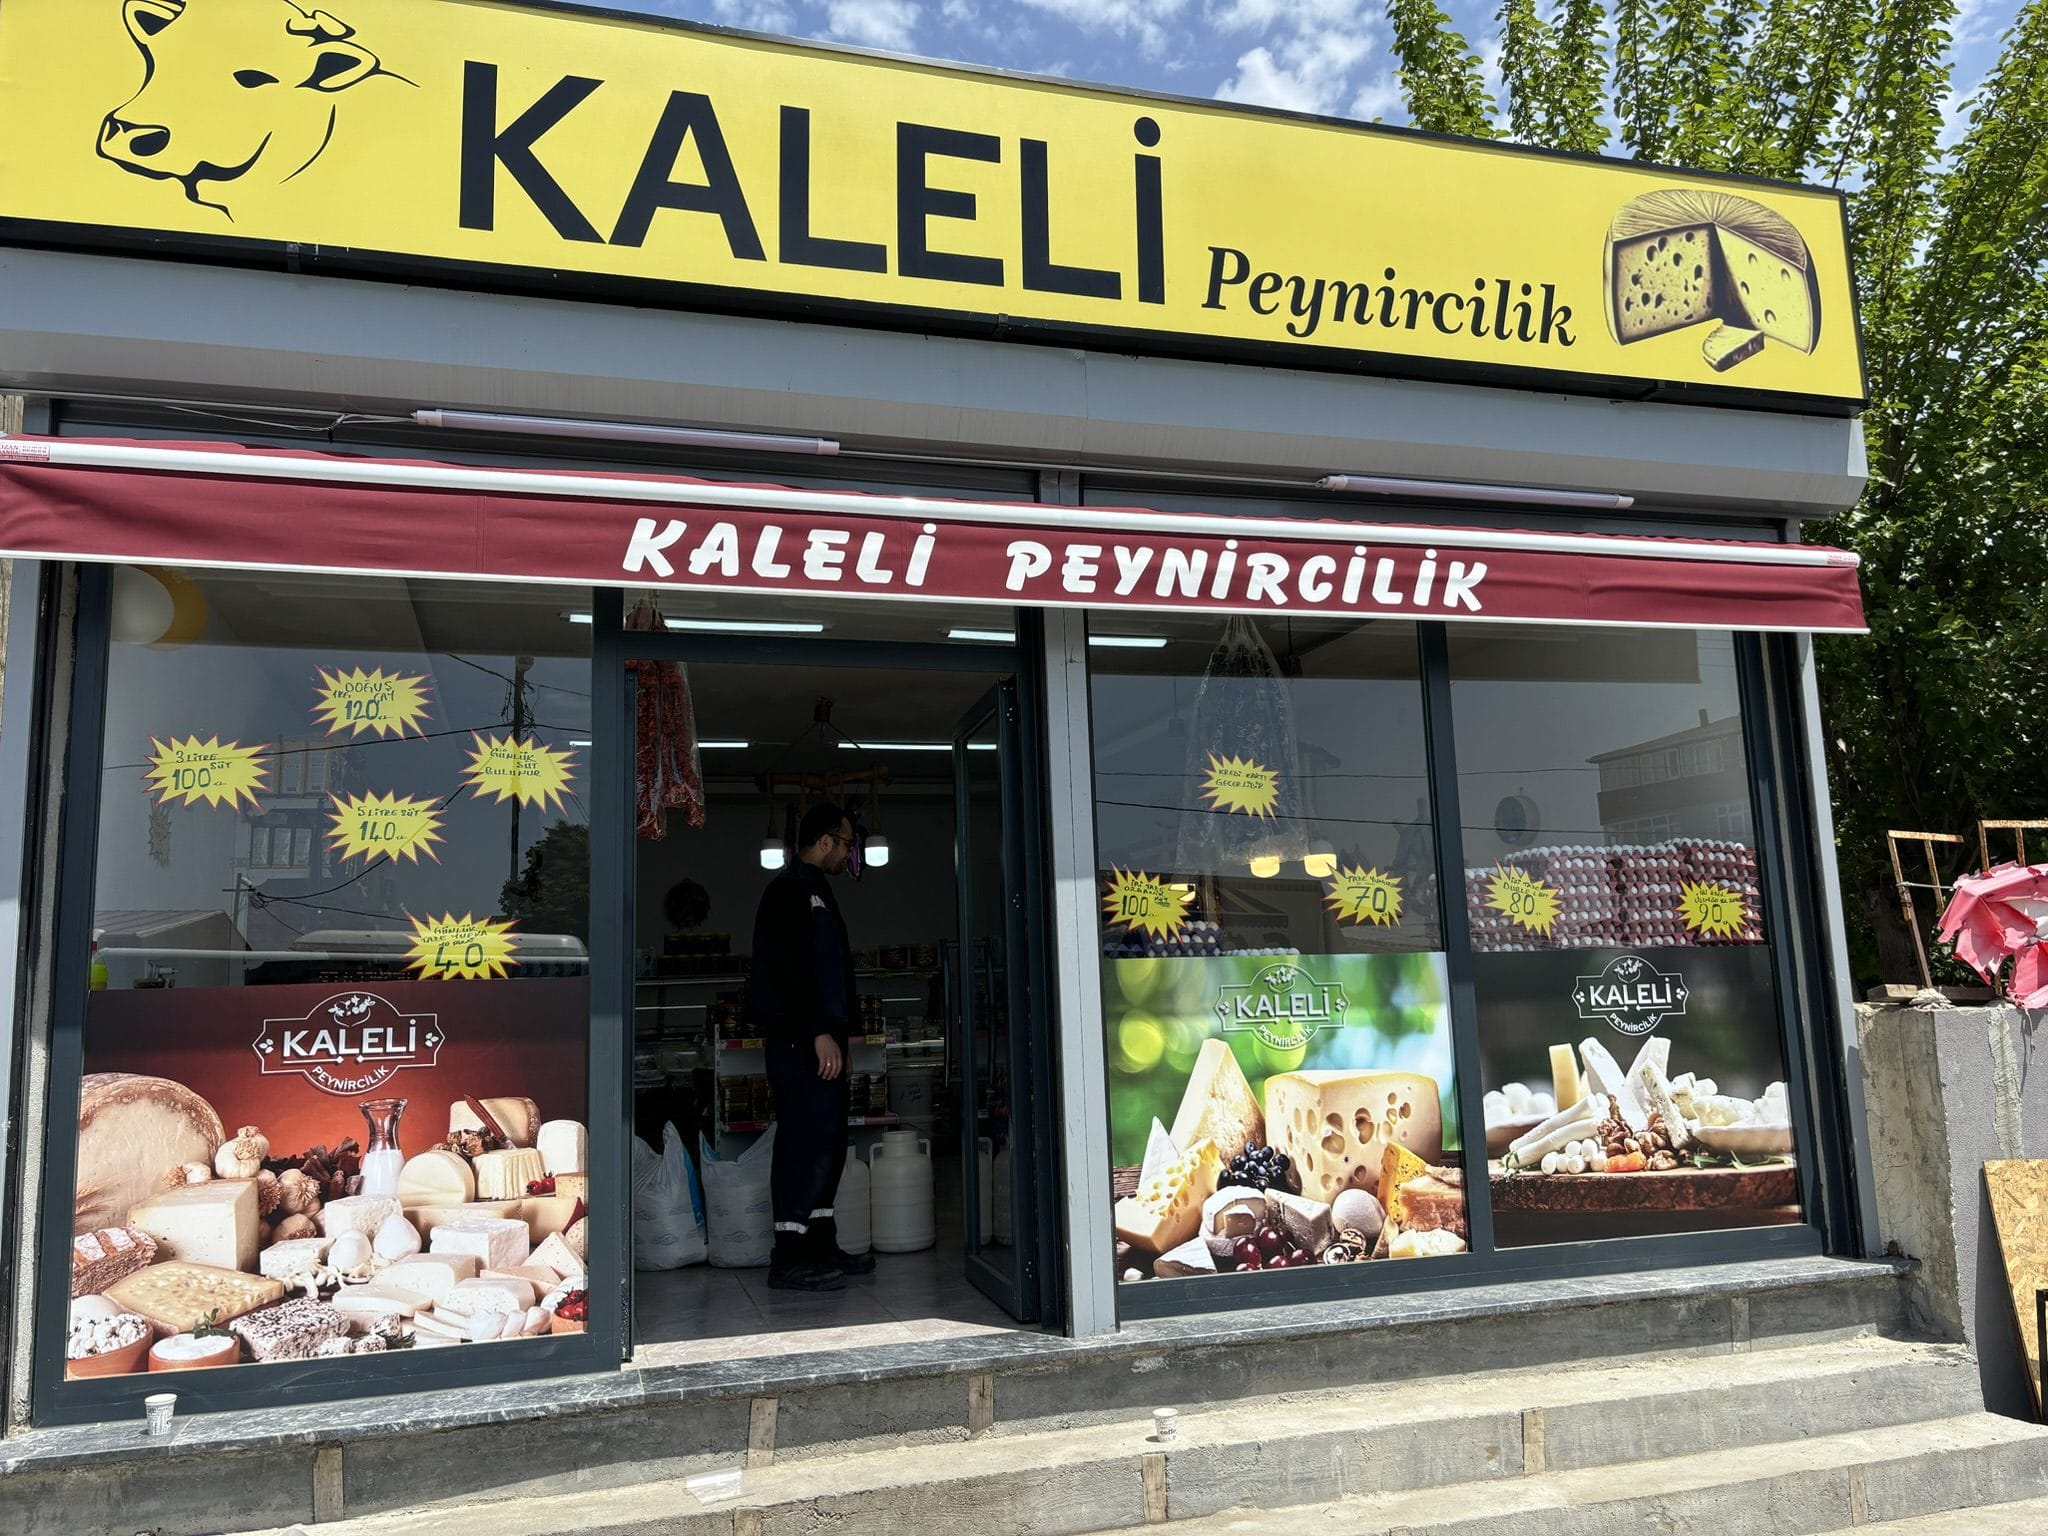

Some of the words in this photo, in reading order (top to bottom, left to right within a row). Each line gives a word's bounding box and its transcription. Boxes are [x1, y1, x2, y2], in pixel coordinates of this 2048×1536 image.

[459, 60, 1166, 305] KALELİ
[1201, 246, 1577, 347] Peynircilik
[622, 517, 937, 587] KALELİ
[1005, 539, 1488, 612] PEYNİRCİLİK
[344, 699, 380, 720] 120
[176, 750, 185, 763] 3
[186, 752, 218, 763] LİTRE
[210, 761, 233, 770] SÜT
[490, 747, 537, 762] GÜNLÜK
[172, 767, 211, 791] 100
[357, 806, 367, 817] 5
[368, 808, 397, 817] LİTRE
[400, 808, 421, 817] SÜT
[360, 821, 397, 842] 140
[1121, 895, 1149, 917] 100
[1346, 886, 1388, 913] 70
[1509, 891, 1536, 916] 80
[1699, 903, 1723, 923] 90
[434, 942, 484, 972] 40
[1234, 986, 1331, 1018] KALELİ
[1589, 976, 1672, 1007] KALELİ
[1608, 1011, 1659, 1033] PEYNİRCİLİK
[282, 1018, 417, 1058] KALELİ
[1257, 1024, 1314, 1048] PEYNİRCİLİK
[311, 1064, 390, 1091] PEYNİRCİLİK
